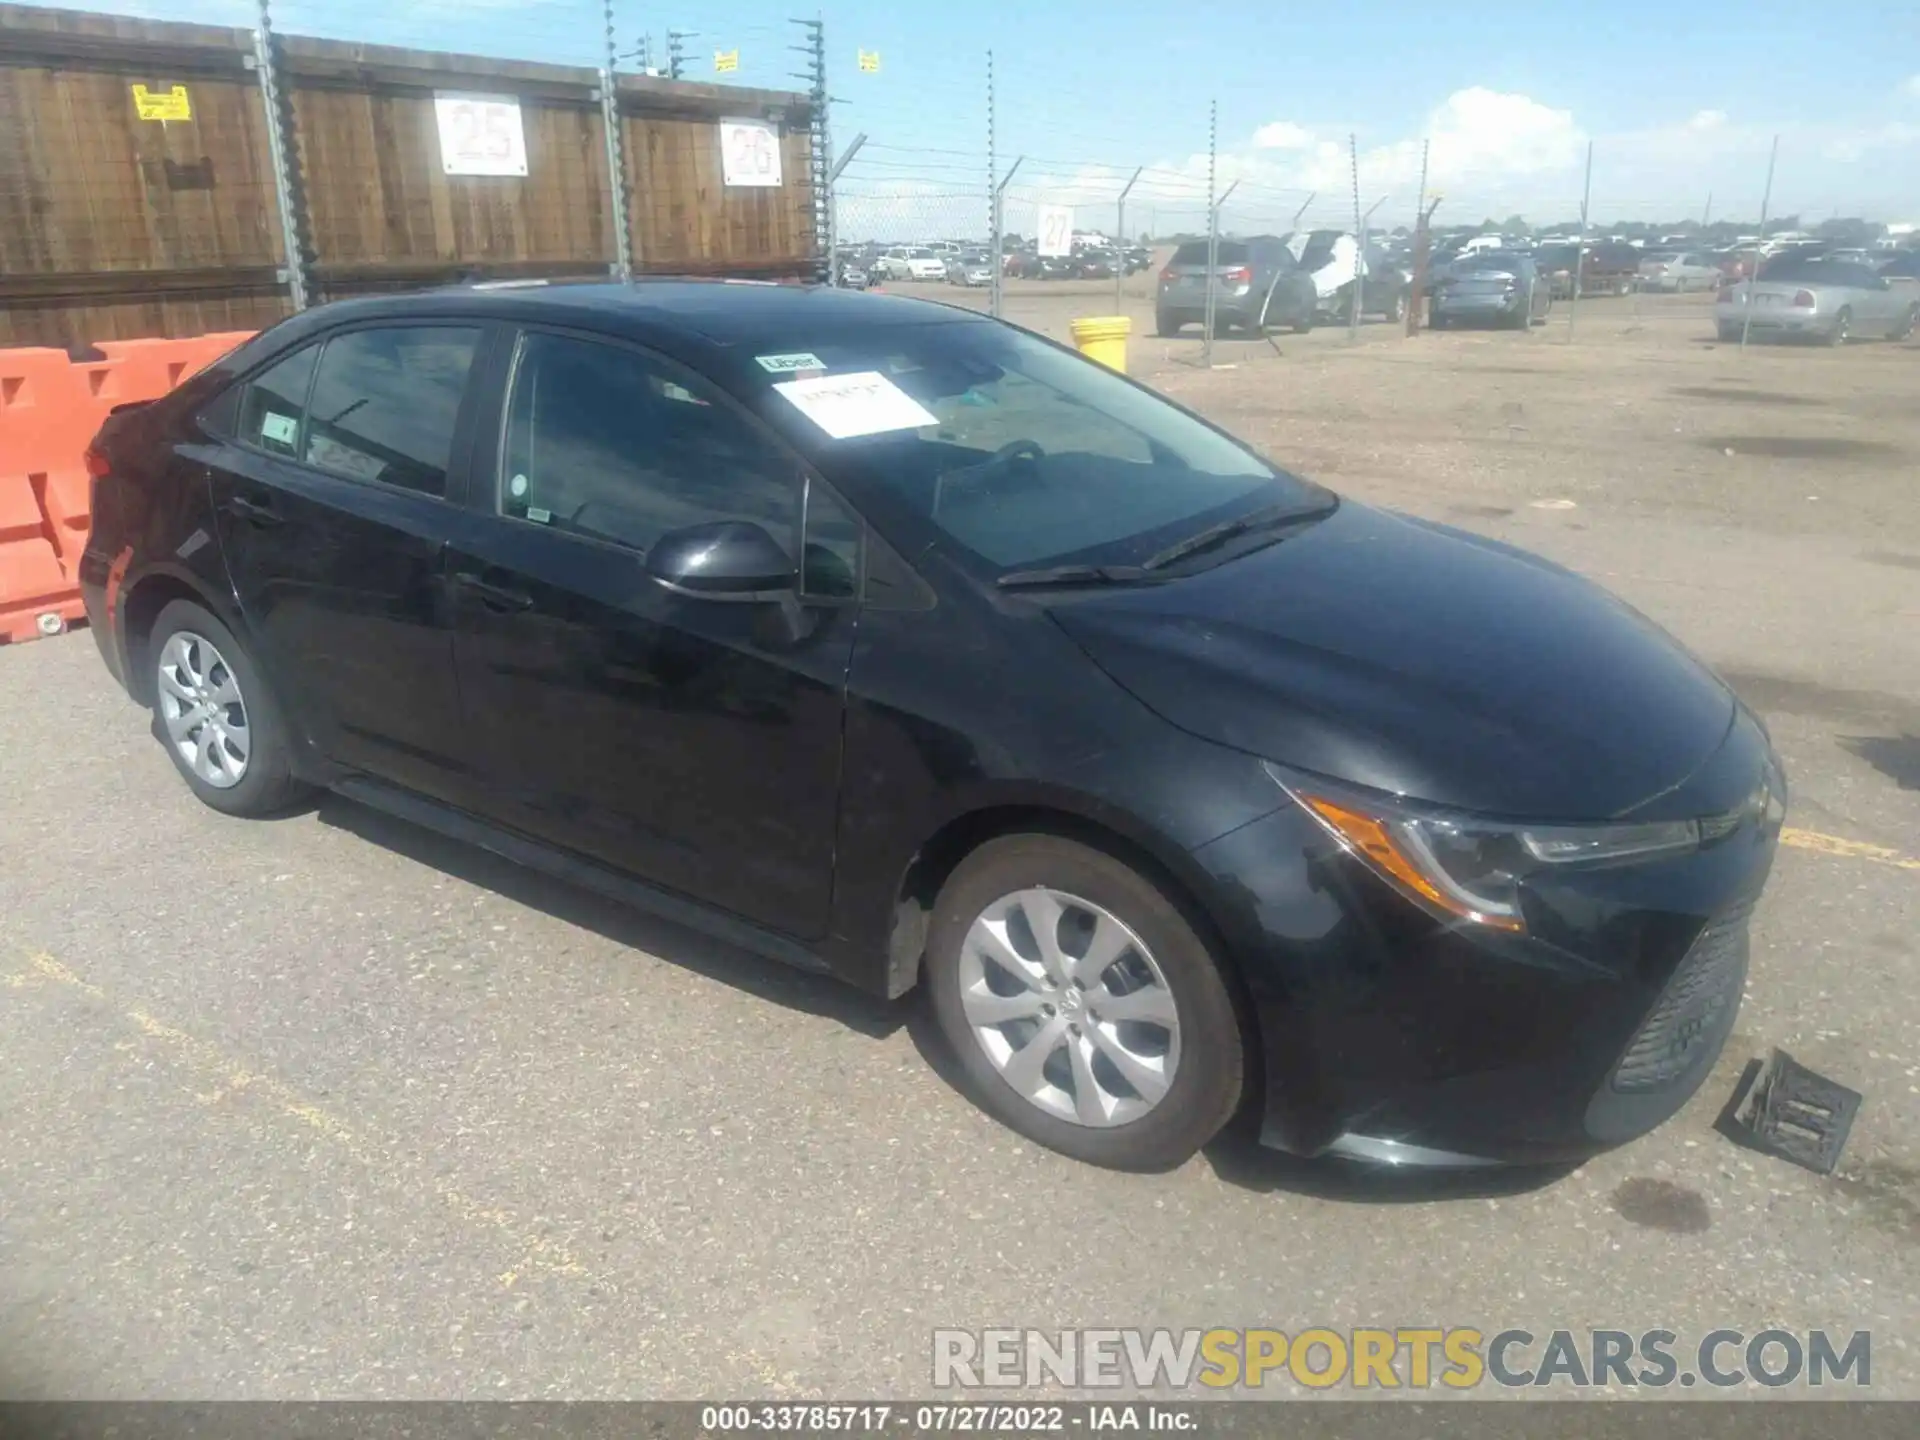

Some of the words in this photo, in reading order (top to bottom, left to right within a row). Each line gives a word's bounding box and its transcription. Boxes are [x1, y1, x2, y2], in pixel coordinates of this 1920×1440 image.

[451, 103, 512, 161] 25
[731, 127, 772, 175] 26
[1045, 213, 1067, 249] 27
[764, 358, 815, 369] Uber
